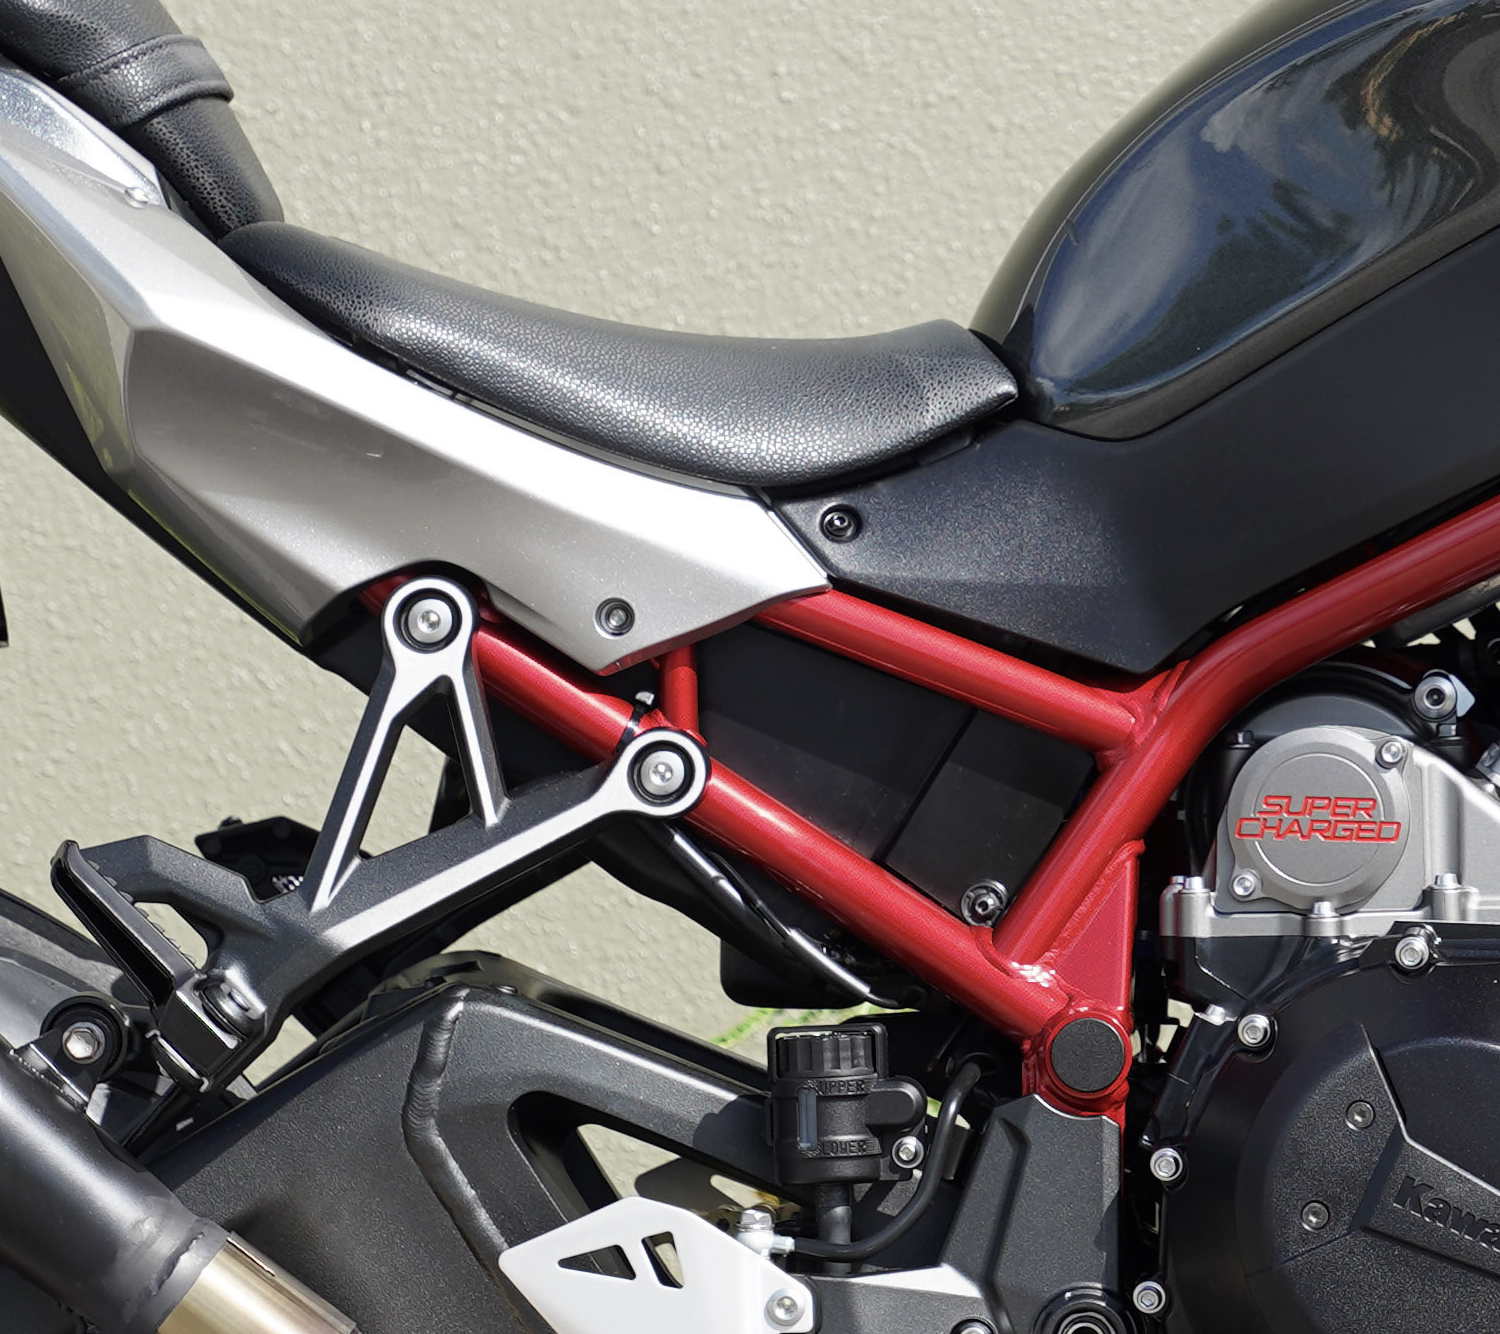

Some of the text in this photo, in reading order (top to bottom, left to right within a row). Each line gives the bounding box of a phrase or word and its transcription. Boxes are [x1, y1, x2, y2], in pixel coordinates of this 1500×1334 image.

[1259, 794, 1377, 818] SUPER
[1235, 817, 1402, 845] CHARGED
[818, 1079, 867, 1094] UPPER
[822, 1140, 868, 1155] LOWER
